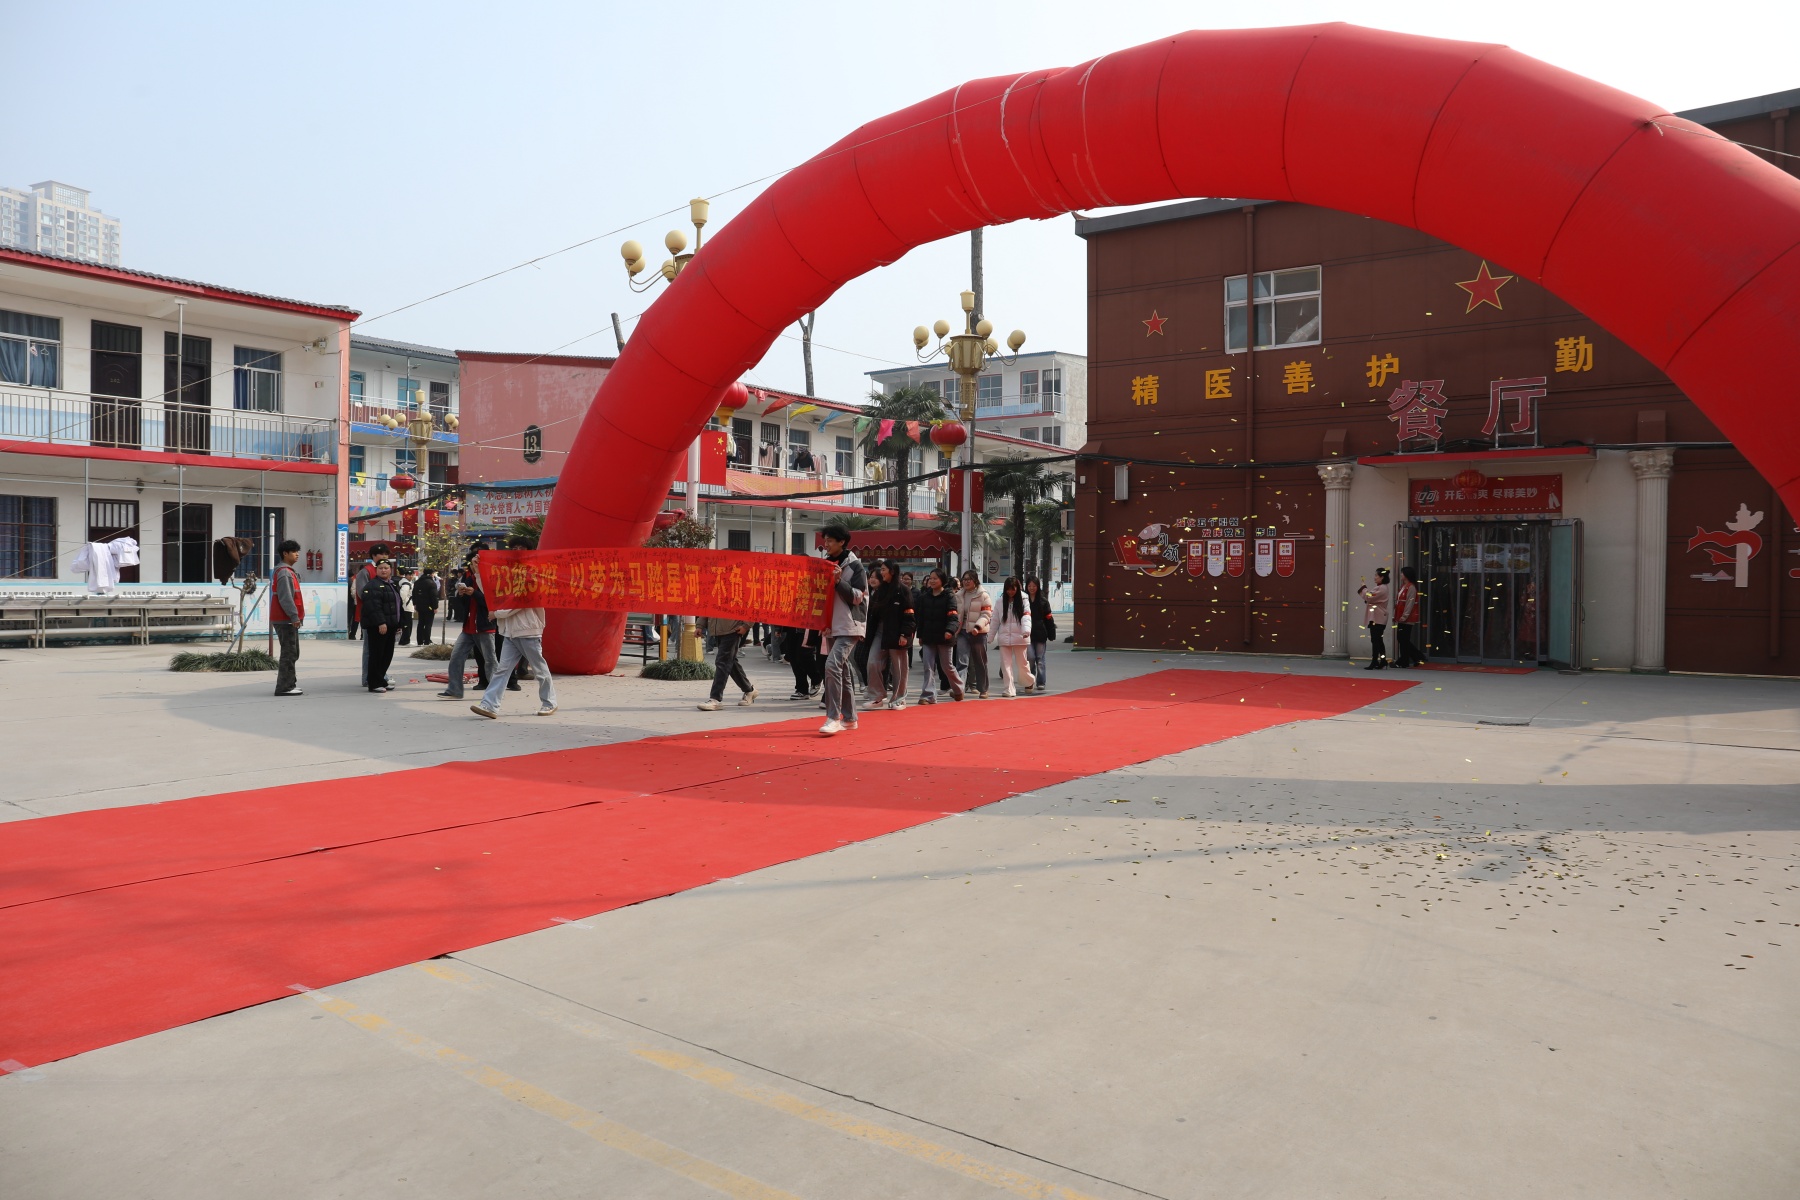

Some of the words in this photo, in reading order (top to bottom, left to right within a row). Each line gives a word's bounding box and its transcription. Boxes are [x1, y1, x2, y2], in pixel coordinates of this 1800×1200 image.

[1554, 335, 1593, 373] 勤
[1387, 376, 1547, 442] 餐厅
[1444, 488, 1489, 500] 开启爽
[569, 561, 701, 604] 以梦为马踏星河
